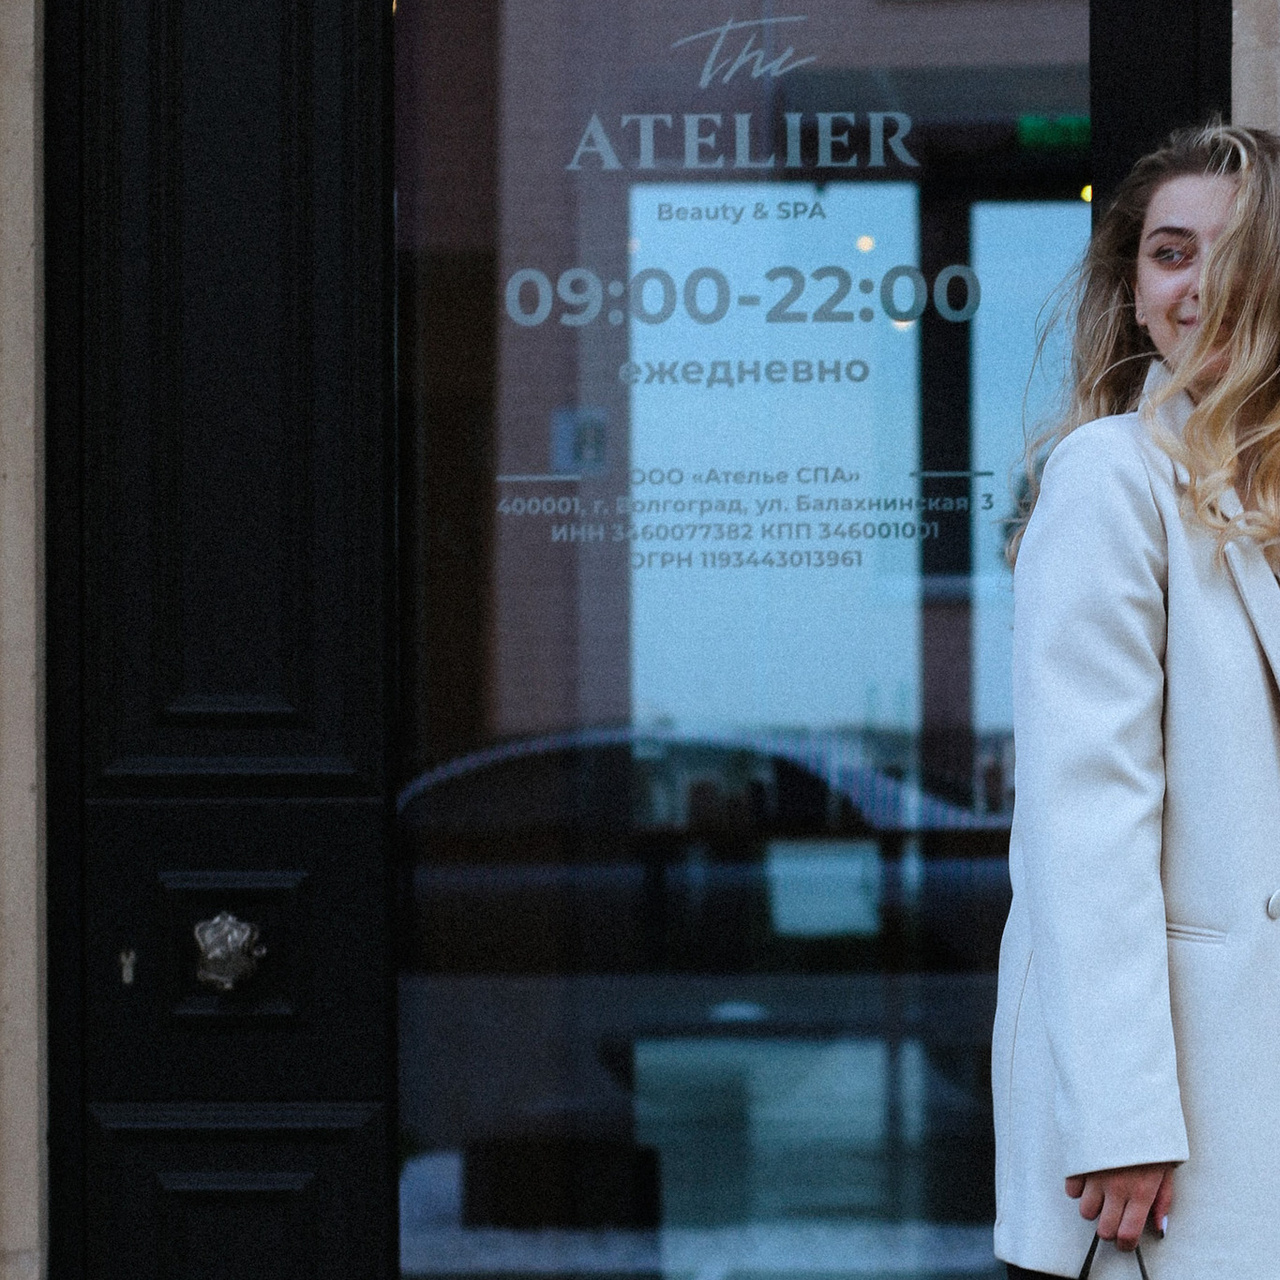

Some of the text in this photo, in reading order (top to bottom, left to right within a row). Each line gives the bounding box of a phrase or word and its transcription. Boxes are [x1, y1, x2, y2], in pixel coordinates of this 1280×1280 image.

[566, 111, 921, 172] ATELIER
[657, 201, 827, 225] Beauty & SPA
[505, 265, 982, 326] 09:00-22:00
[618, 359, 870, 388] ежедневно
[692, 468, 789, 486] «Ателье
[796, 466, 860, 485] СПА»
[497, 496, 587, 517] 400001,
[756, 497, 788, 516] ул.
[981, 493, 994, 511] 3
[551, 523, 605, 542] ИНН
[761, 522, 812, 540] КПП
[818, 521, 939, 540] 346001001
